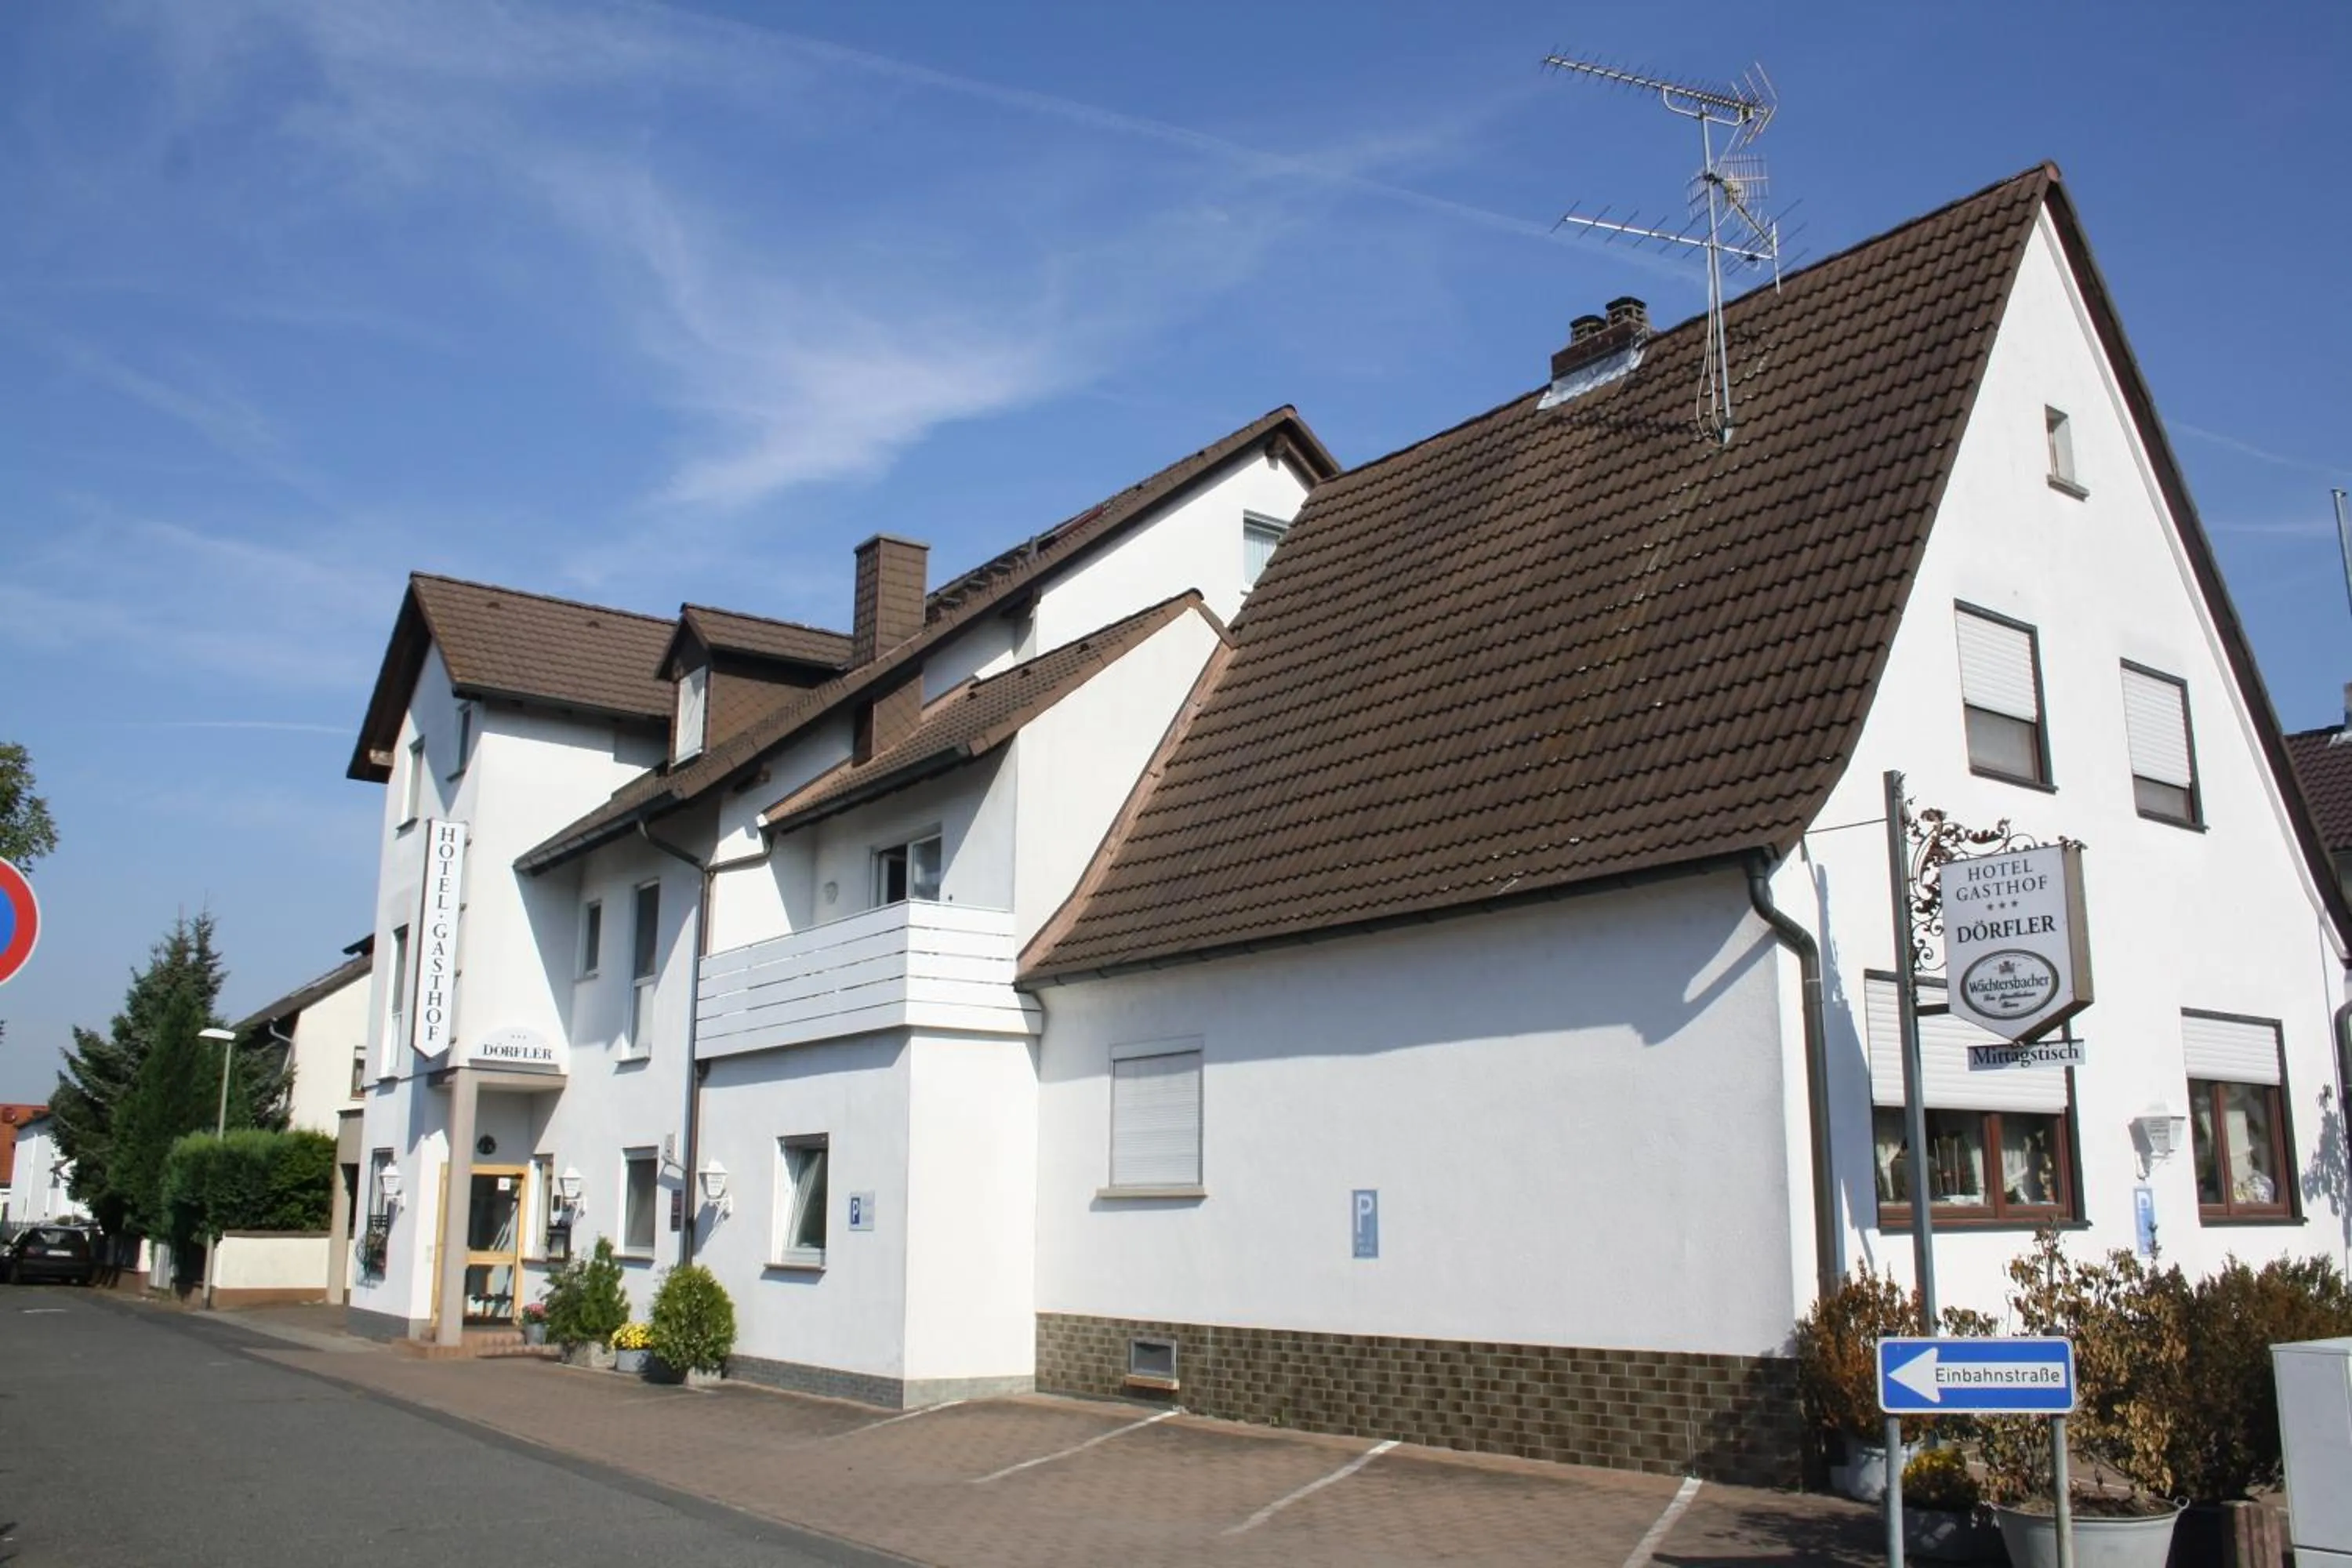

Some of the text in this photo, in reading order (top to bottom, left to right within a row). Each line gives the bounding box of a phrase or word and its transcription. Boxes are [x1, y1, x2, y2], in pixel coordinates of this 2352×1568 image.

[1967, 859, 2033, 882] HOTEL
[1956, 876, 2049, 902] GASTHOF
[426, 826, 455, 1041] HOTEL GASTHOF
[1957, 914, 2057, 943] DÖRFLER
[1973, 1043, 2079, 1067] Mittagstisch
[1358, 1194, 1372, 1232] P
[1936, 1367, 2060, 1382] Einbahnstraße
